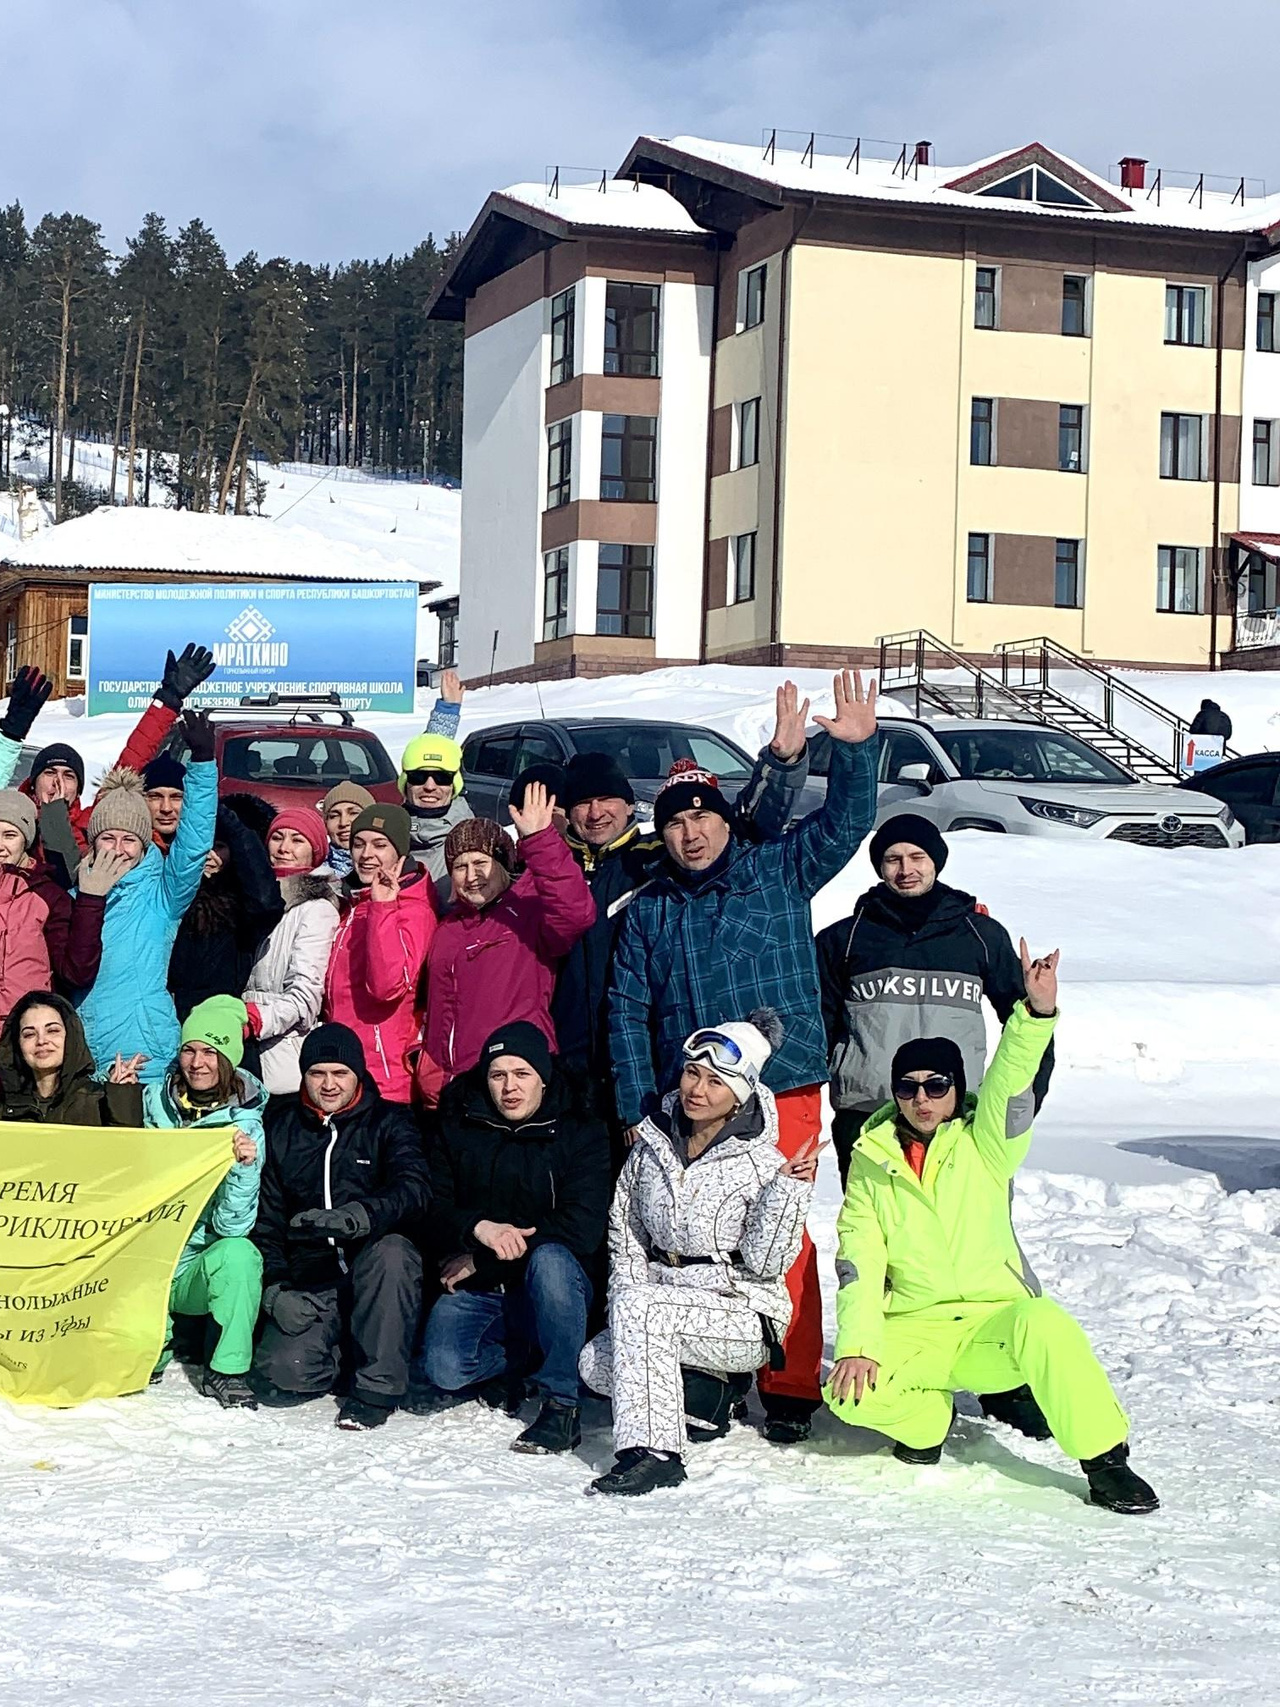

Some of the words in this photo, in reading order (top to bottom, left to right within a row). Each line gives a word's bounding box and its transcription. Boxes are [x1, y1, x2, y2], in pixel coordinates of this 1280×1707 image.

[94, 588, 153, 599] МИНИСТЕРСТВО
[156, 587, 212, 600] МОЛОДЕЖНОЙ
[214, 588, 256, 599] ПОЛИТИКИ
[265, 588, 295, 599] СПОРТА
[297, 588, 350, 599] РЕСПУБЛИКИ
[352, 588, 414, 599] БАШКОРТОСТАН
[99, 681, 163, 693] ГОСУДАРСТВЕ
[191, 681, 242, 693] ЮДЖЕТНОЕ
[245, 682, 305, 693] УЧРЕЖДЕНИЕ
[308, 682, 367, 693] СПОРТИВНАЯ
[369, 682, 403, 694] ШКОЛА
[341, 698, 372, 709] ПОРТУ
[19, 1328, 45, 1343] из
